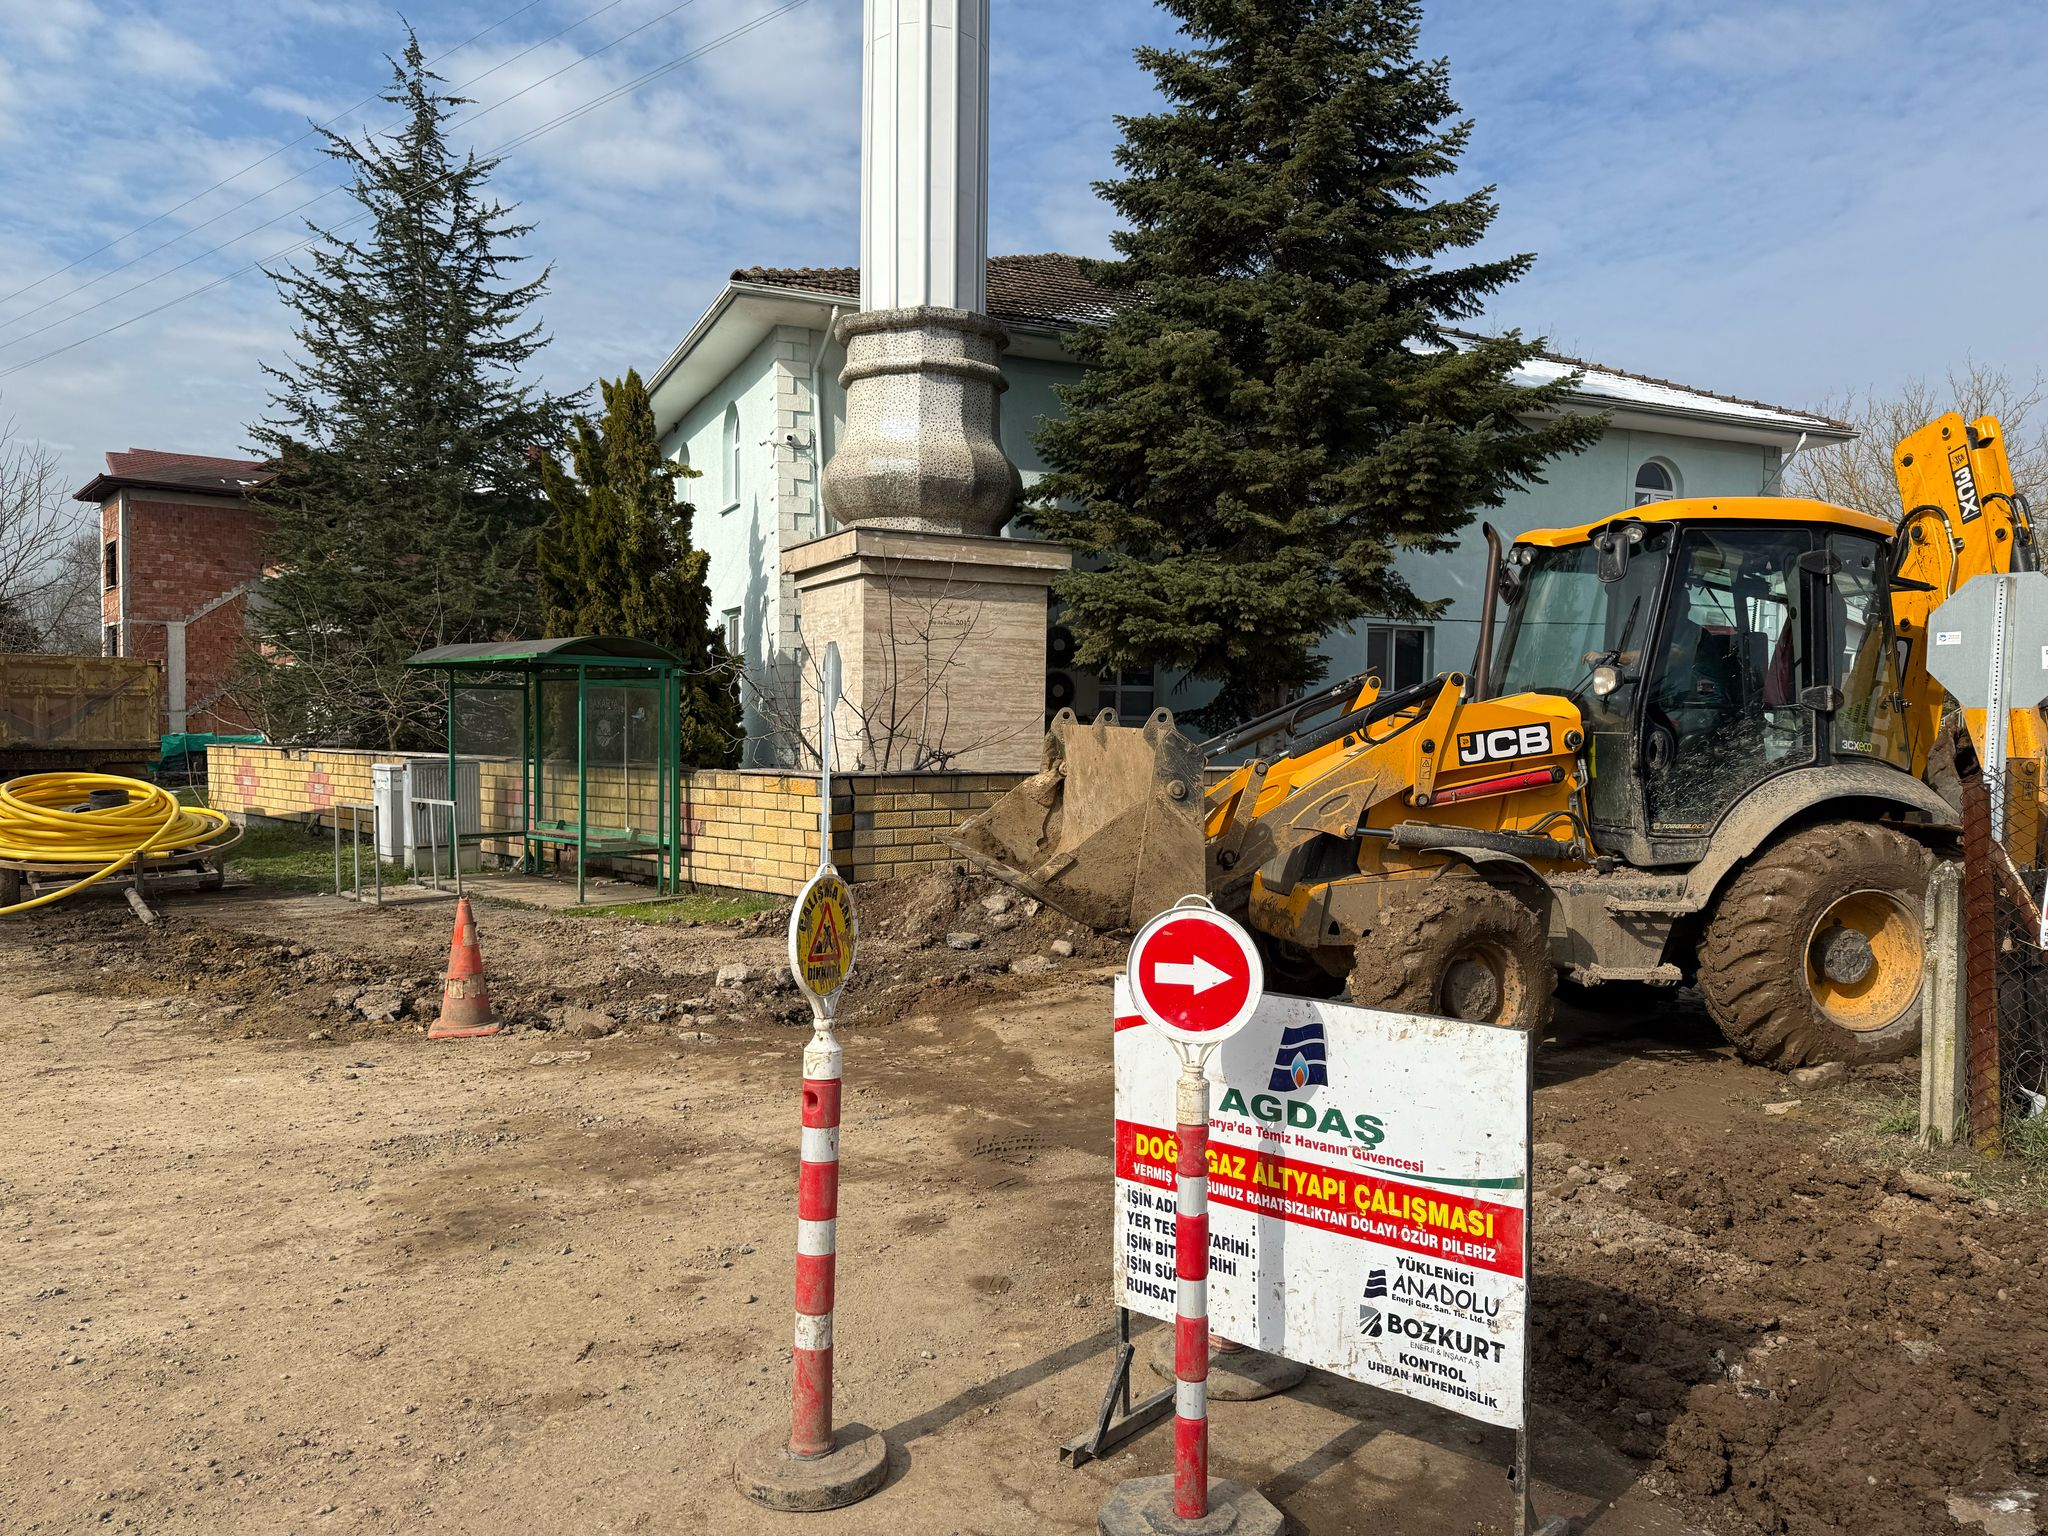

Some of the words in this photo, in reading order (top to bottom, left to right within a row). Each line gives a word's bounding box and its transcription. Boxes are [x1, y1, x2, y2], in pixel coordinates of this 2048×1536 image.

[1954, 466, 1980, 518] 3CX
[1461, 726, 1550, 762] JCB
[1209, 1118, 1252, 1135] arya'da
[1256, 1125, 1291, 1144] Temiz
[1295, 1134, 1348, 1157] Havanın
[1218, 1088, 1386, 1150] AGDAŞ
[1127, 1185, 1152, 1208] İŞİN
[1133, 1162, 1172, 1186] VERMİŞ
[1351, 1215, 1397, 1240] DOLAYI
[1402, 1225, 1438, 1249] ÖZÜR
[1442, 1235, 1497, 1262] DİLERİZ
[1252, 1162, 1346, 1204] ALTYAPI
[1354, 1184, 1494, 1239] ÇALIŞMASI
[1127, 1210, 1151, 1230] YER
[1127, 1229, 1151, 1253] İŞİN
[1127, 1251, 1151, 1275] İŞİN
[1396, 1256, 1475, 1287] YÜKLENİCİ
[1391, 1293, 1414, 1306] Enerji
[1392, 1273, 1500, 1317] ANADOLU
[1388, 1312, 1506, 1364] BOZKURT
[1368, 1360, 1409, 1380] URBAN
[1412, 1373, 1499, 1409] MÜHENDİSLİK
[1399, 1352, 1467, 1384] KONTROL
